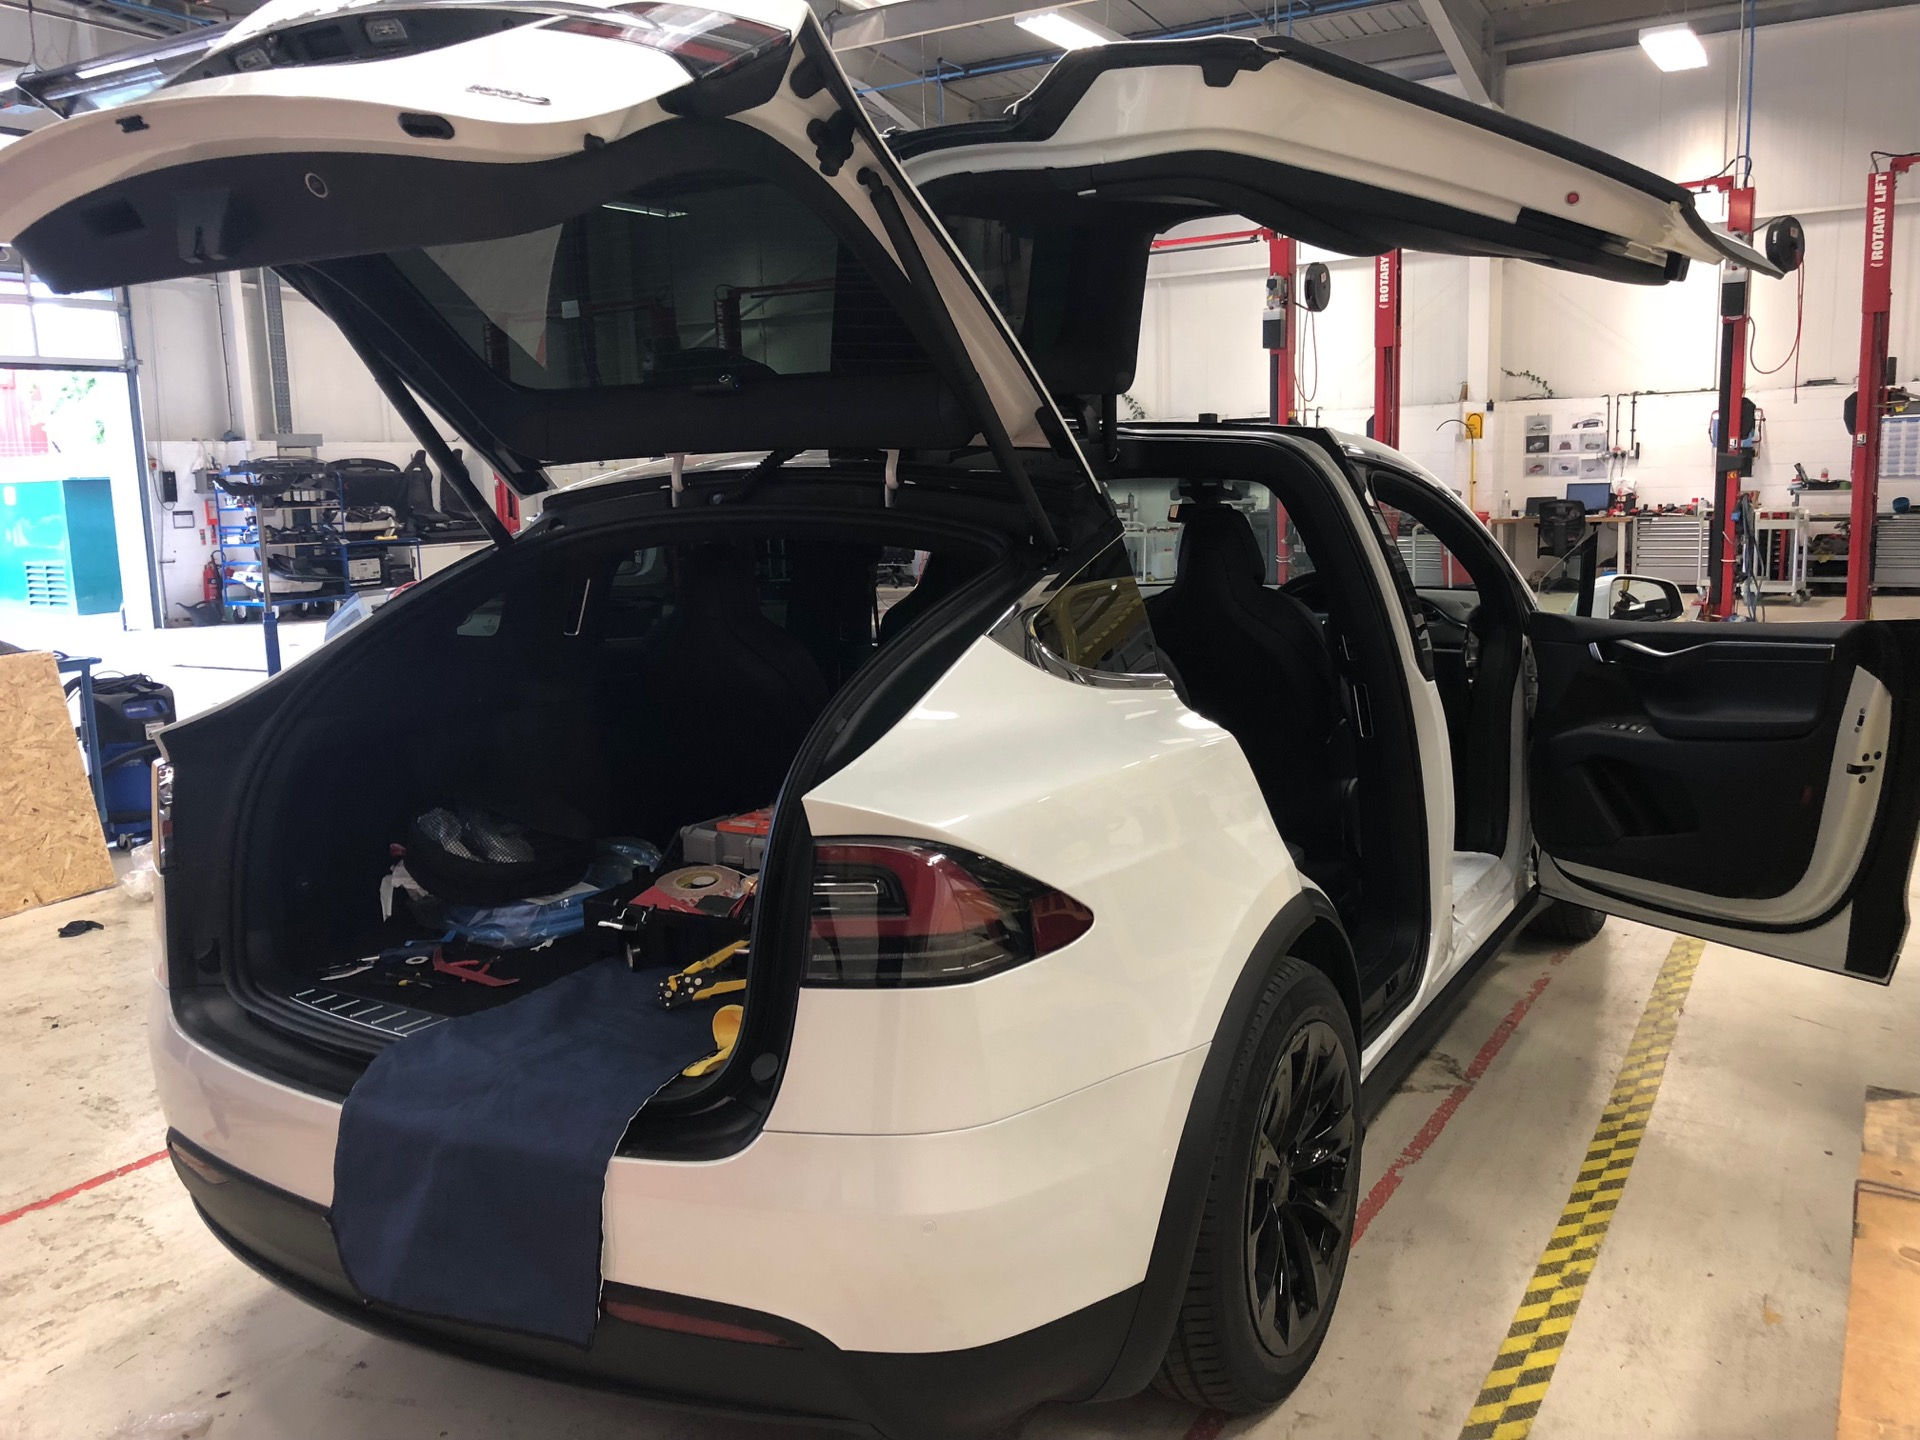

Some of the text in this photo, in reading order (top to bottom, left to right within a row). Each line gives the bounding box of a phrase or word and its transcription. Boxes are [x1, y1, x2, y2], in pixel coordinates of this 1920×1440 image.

[1871, 173, 1888, 261] ROTARY LIFT
[1379, 256, 1390, 303] ROTARY
